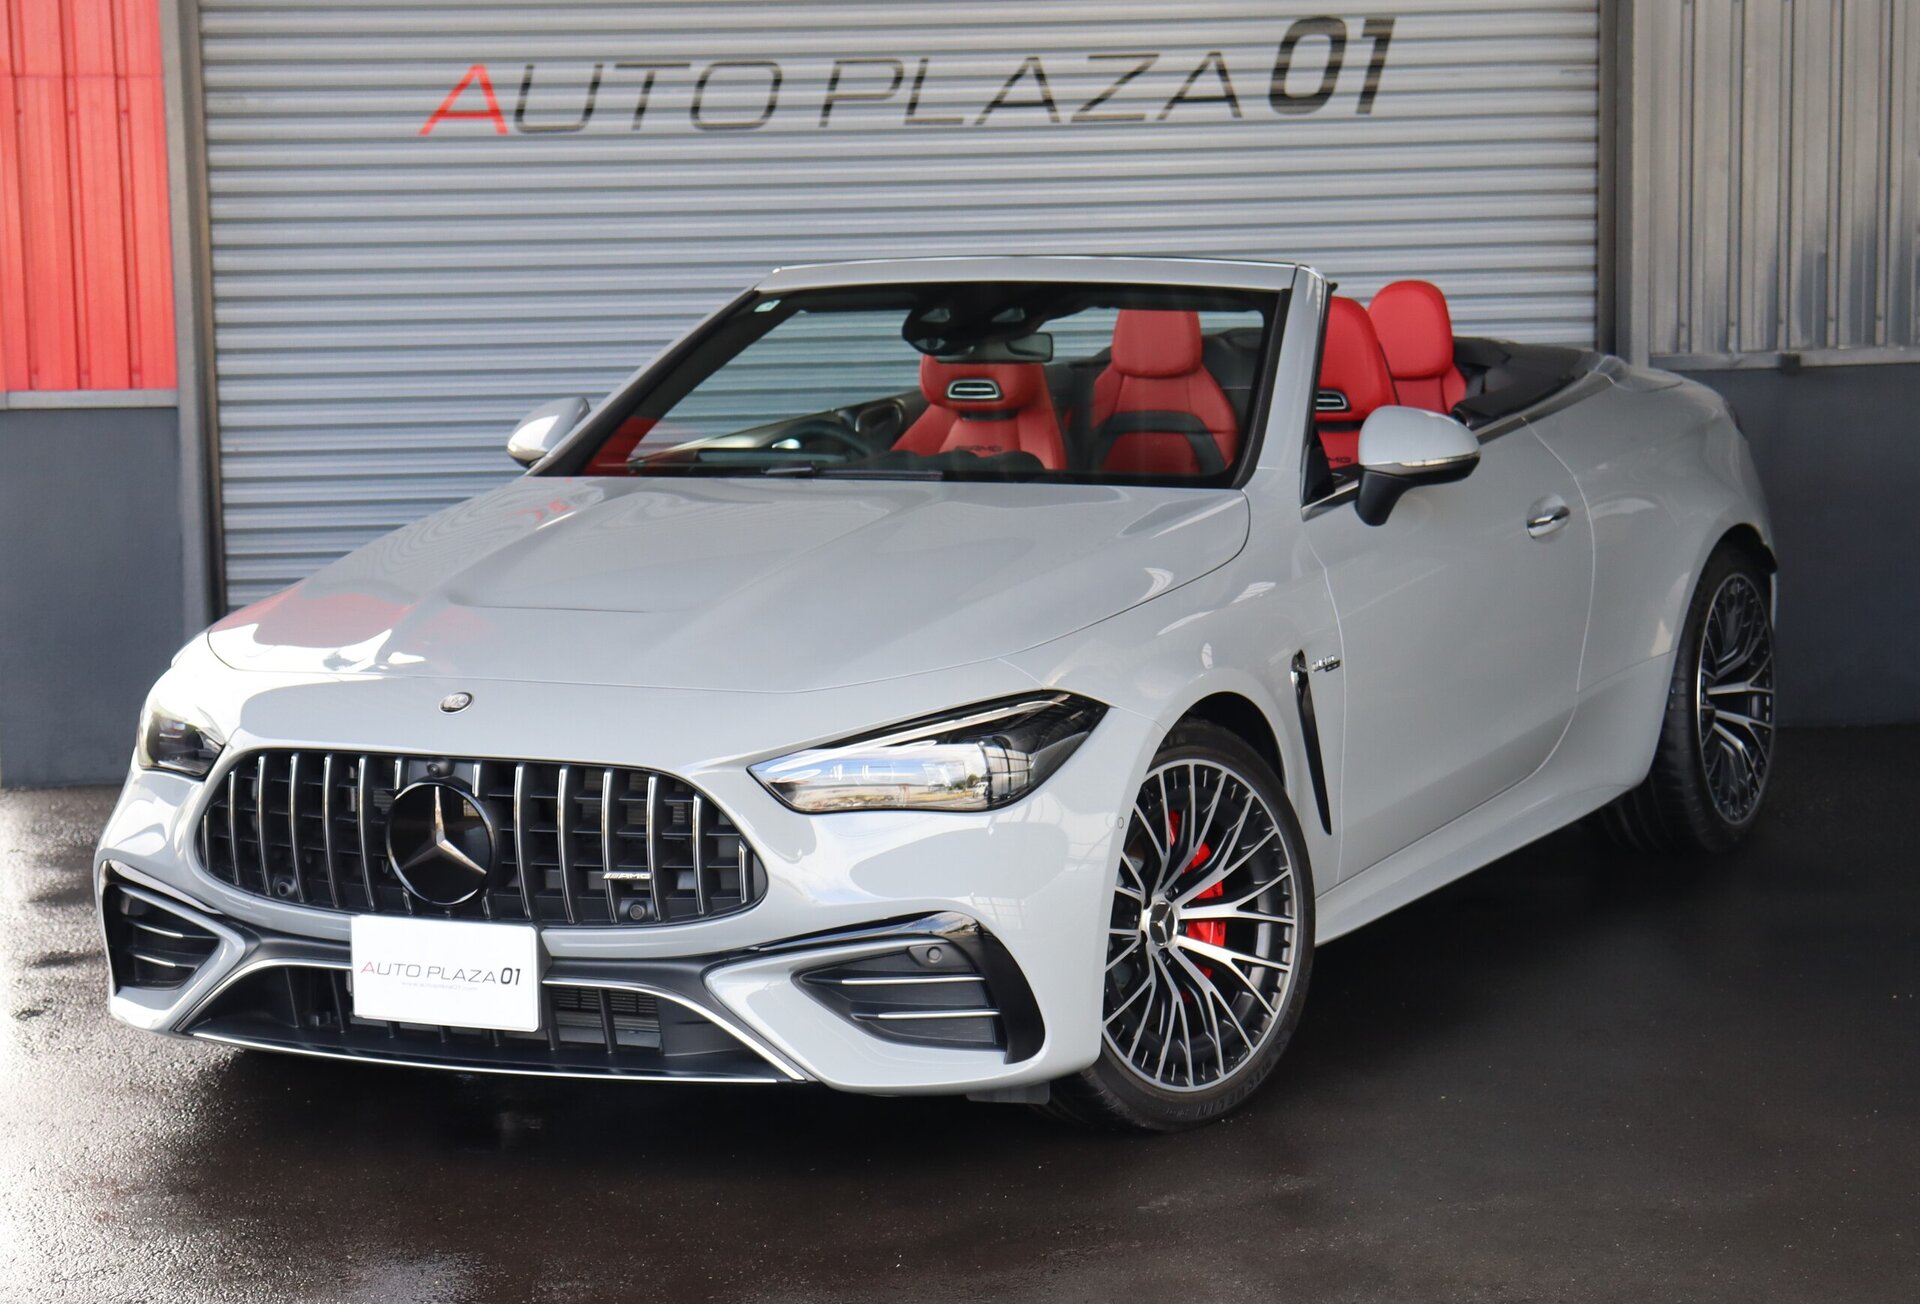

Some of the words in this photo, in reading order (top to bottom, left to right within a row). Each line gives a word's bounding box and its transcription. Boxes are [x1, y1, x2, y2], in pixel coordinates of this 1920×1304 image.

[419, 61, 783, 135] AUTO
[818, 52, 1243, 127] PLAZA
[1268, 15, 1396, 116] 01
[360, 961, 421, 978] AUTO
[427, 966, 497, 984] PLAZA
[500, 967, 521, 986] 01
